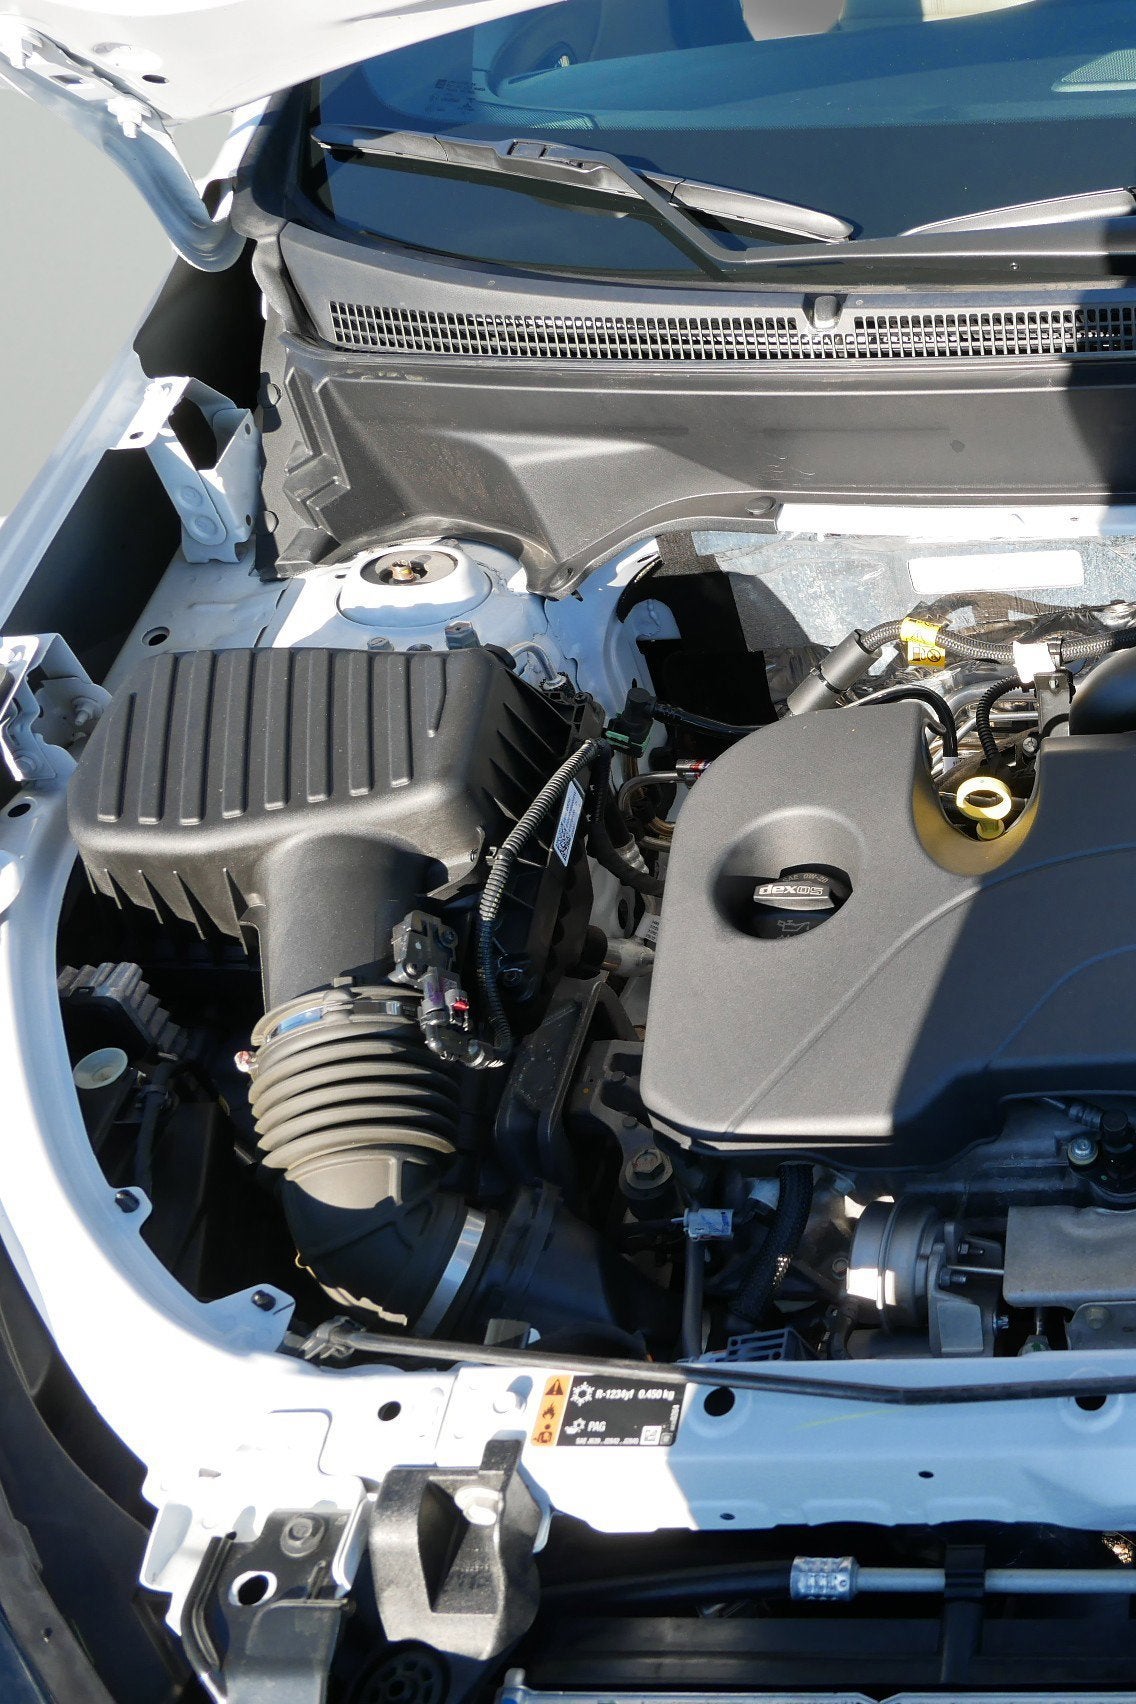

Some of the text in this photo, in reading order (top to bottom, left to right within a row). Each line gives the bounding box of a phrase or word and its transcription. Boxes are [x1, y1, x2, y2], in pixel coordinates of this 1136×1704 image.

[803, 873, 829, 884] 0W-20
[758, 884, 824, 896] dexos
[595, 1387, 675, 1401] R-1234yf 0.450 kg
[587, 1420, 606, 1432] PAG
